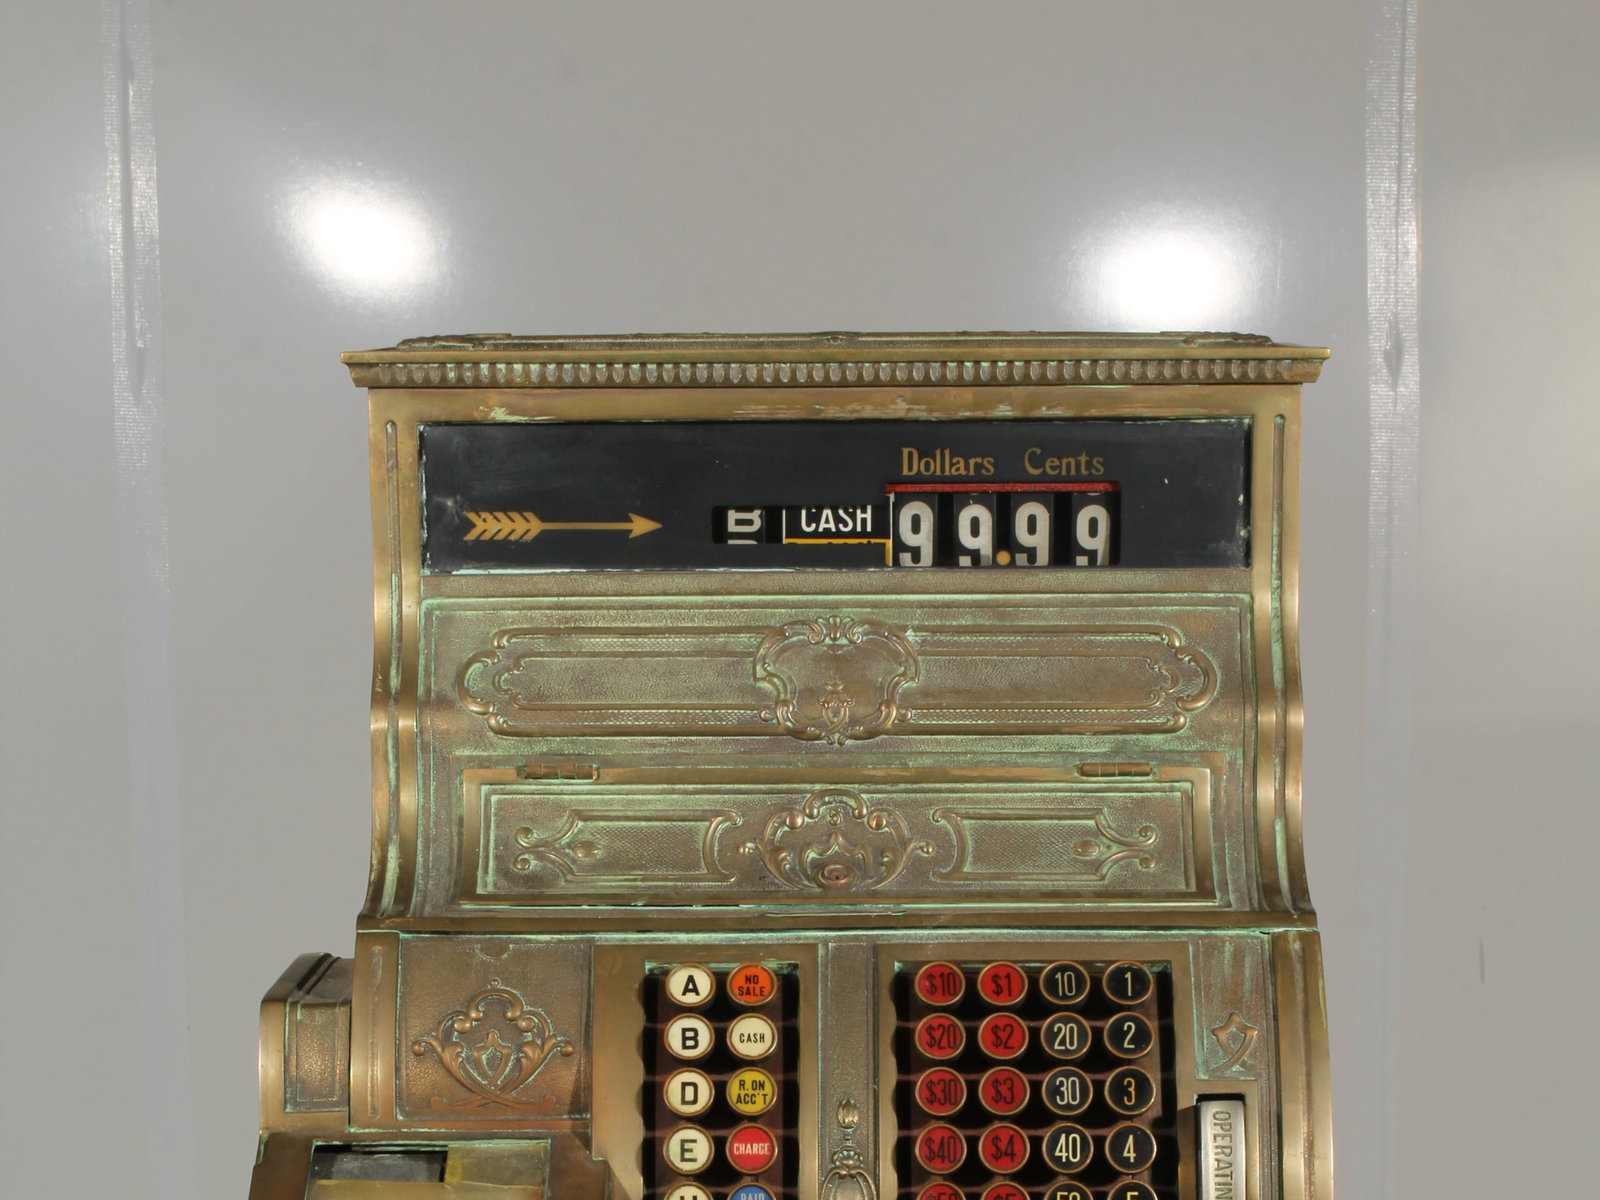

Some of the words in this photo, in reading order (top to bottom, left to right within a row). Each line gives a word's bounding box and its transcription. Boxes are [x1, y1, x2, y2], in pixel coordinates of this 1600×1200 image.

[901, 447, 994, 476] Dollars
[1024, 448, 1104, 475] Cents
[801, 505, 872, 532] CASH
[682, 975, 700, 996] A
[738, 986, 765, 997] SALE
[745, 975, 759, 984] NO
[927, 971, 957, 996] $10
[992, 973, 1012, 996] $1
[1055, 971, 1075, 996] 10
[1125, 972, 1132, 996] 1
[682, 1028, 699, 1050] B
[739, 1033, 765, 1043] CASH
[926, 1024, 957, 1049] $20
[992, 1025, 1014, 1049] $2
[1053, 1024, 1078, 1049] 20
[1123, 1023, 1135, 1048] 2
[681, 1082, 698, 1105] D
[739, 1080, 749, 1091] R.
[752, 1080, 765, 1091] ON
[926, 1080, 958, 1106] $30
[991, 1079, 1015, 1105] $3
[1056, 1078, 1080, 1105] 30
[1123, 1078, 1136, 1105] 3
[736, 1093, 768, 1105] ACC'T
[680, 1139, 698, 1162] E
[733, 1143, 770, 1155] CHARGE
[925, 1136, 957, 1163] $40
[991, 1135, 1016, 1163] $4
[1055, 1134, 1081, 1163] 40
[1123, 1135, 1136, 1163] 4
